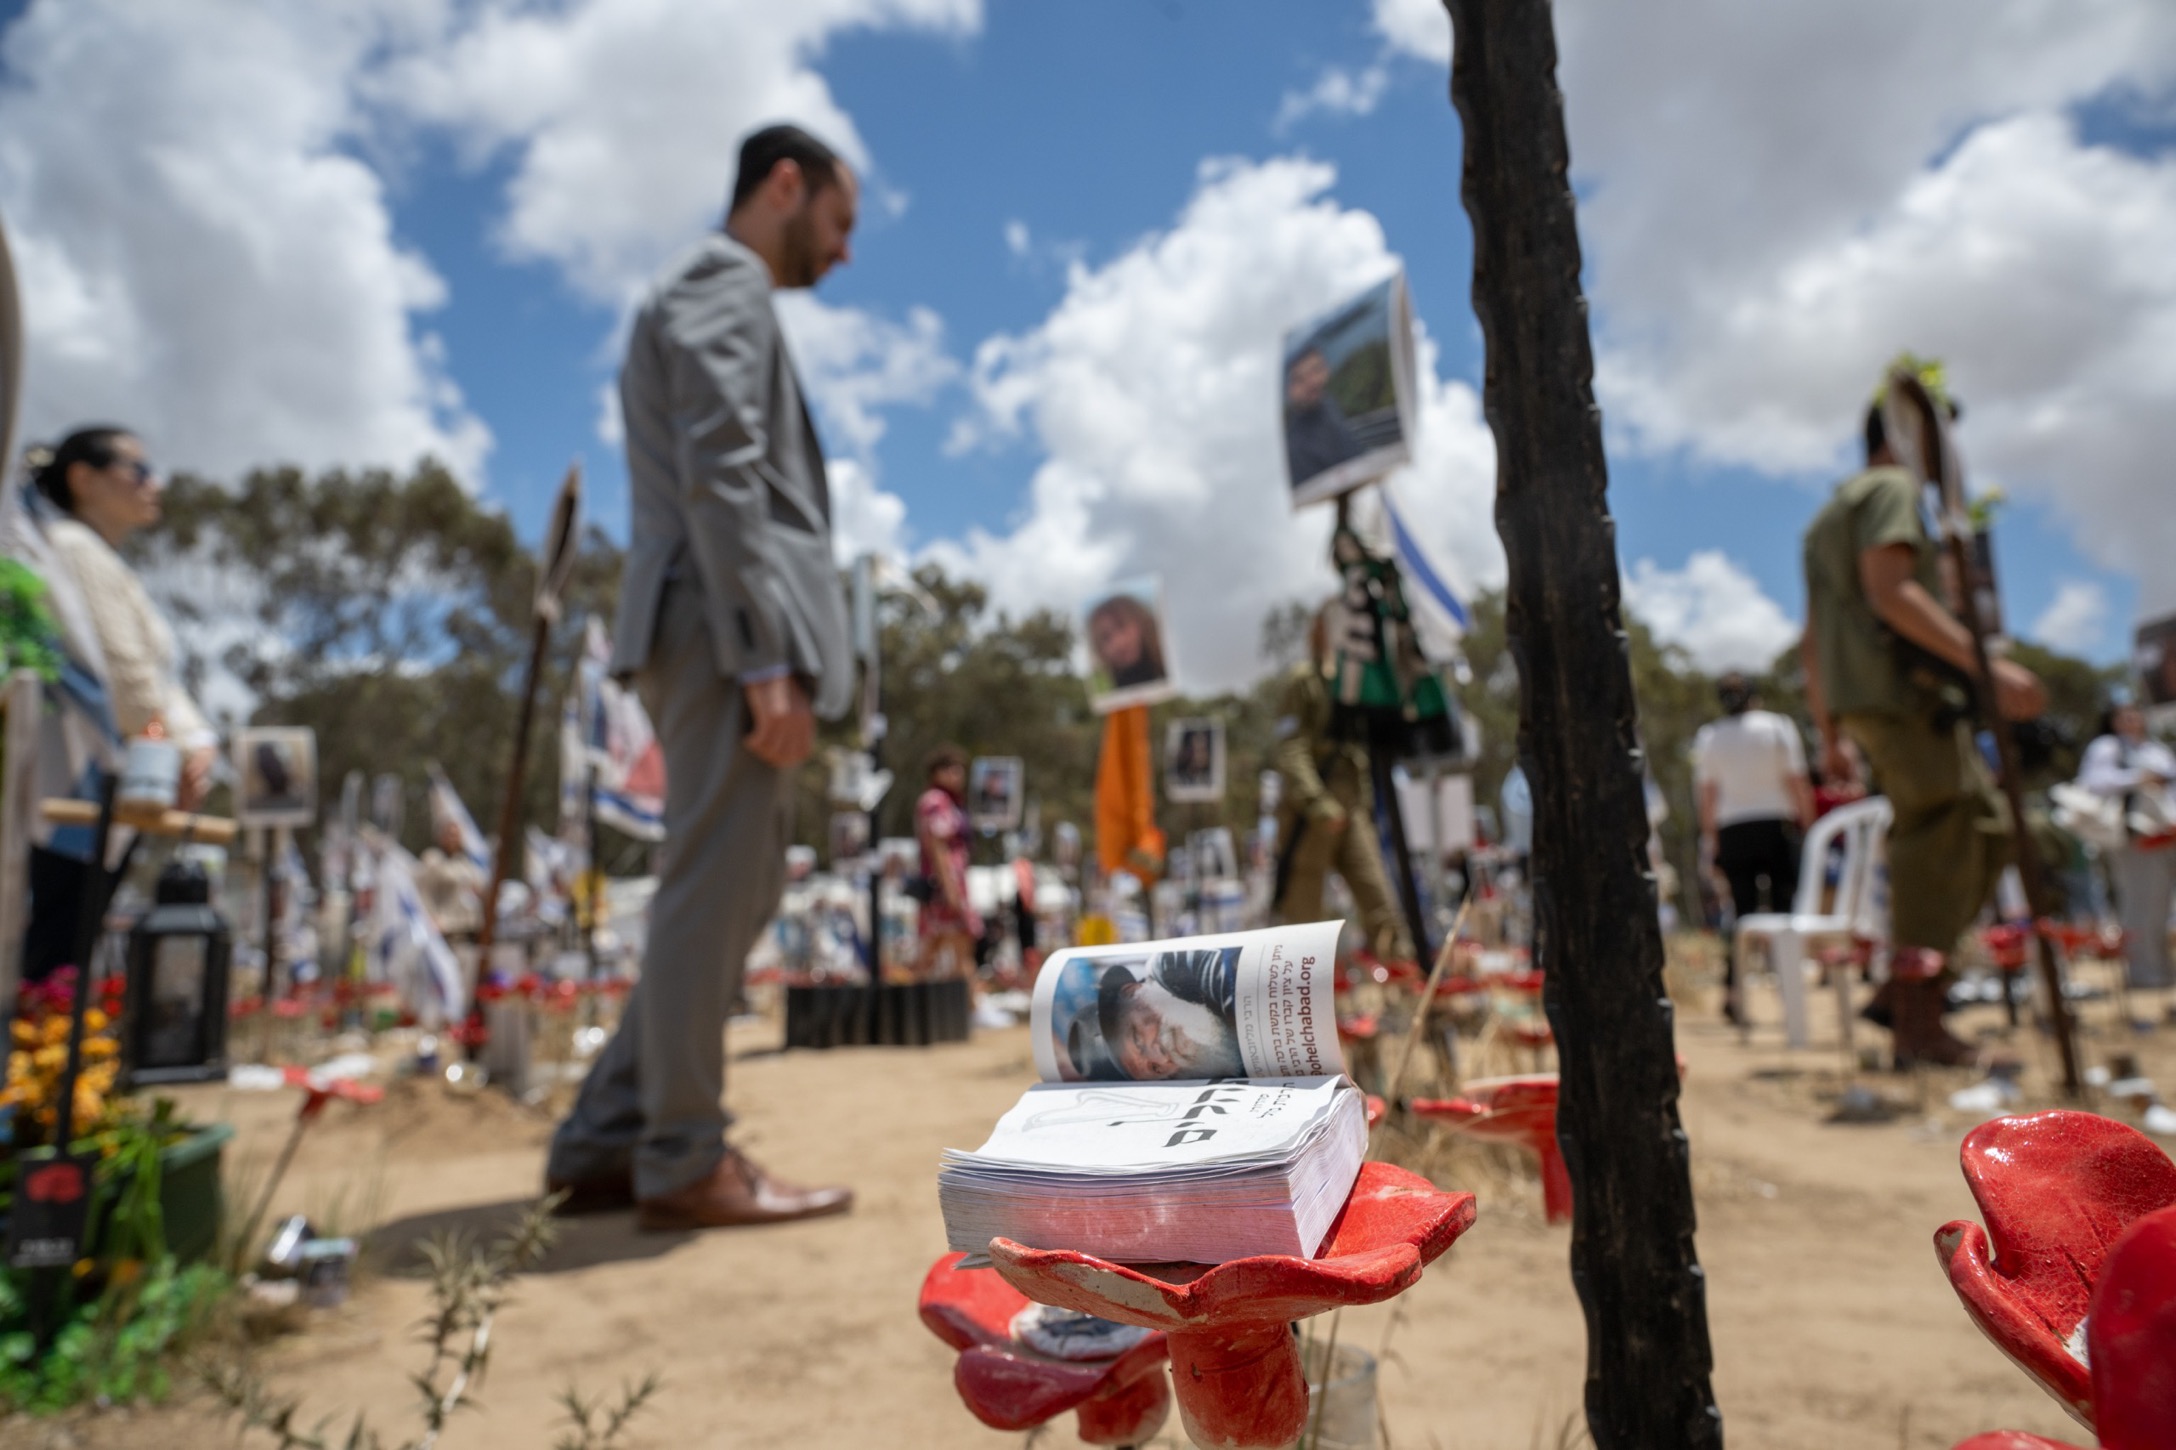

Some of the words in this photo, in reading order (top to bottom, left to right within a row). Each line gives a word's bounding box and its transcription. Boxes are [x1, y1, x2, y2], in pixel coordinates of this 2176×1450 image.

[1272, 944, 1283, 962] ניתן
[1282, 960, 1293, 975] על
[1267, 964, 1279, 999] לשלוח
[1282, 977, 1293, 996] ציון
[1243, 995, 1252, 1021] הרבי
[1269, 1001, 1281, 1036] בקשת
[1283, 999, 1294, 1025] קברו
[1286, 1028, 1295, 1045] של
[1273, 1039, 1285, 1063] ברכה
[1288, 1047, 1300, 1067] הרבי
